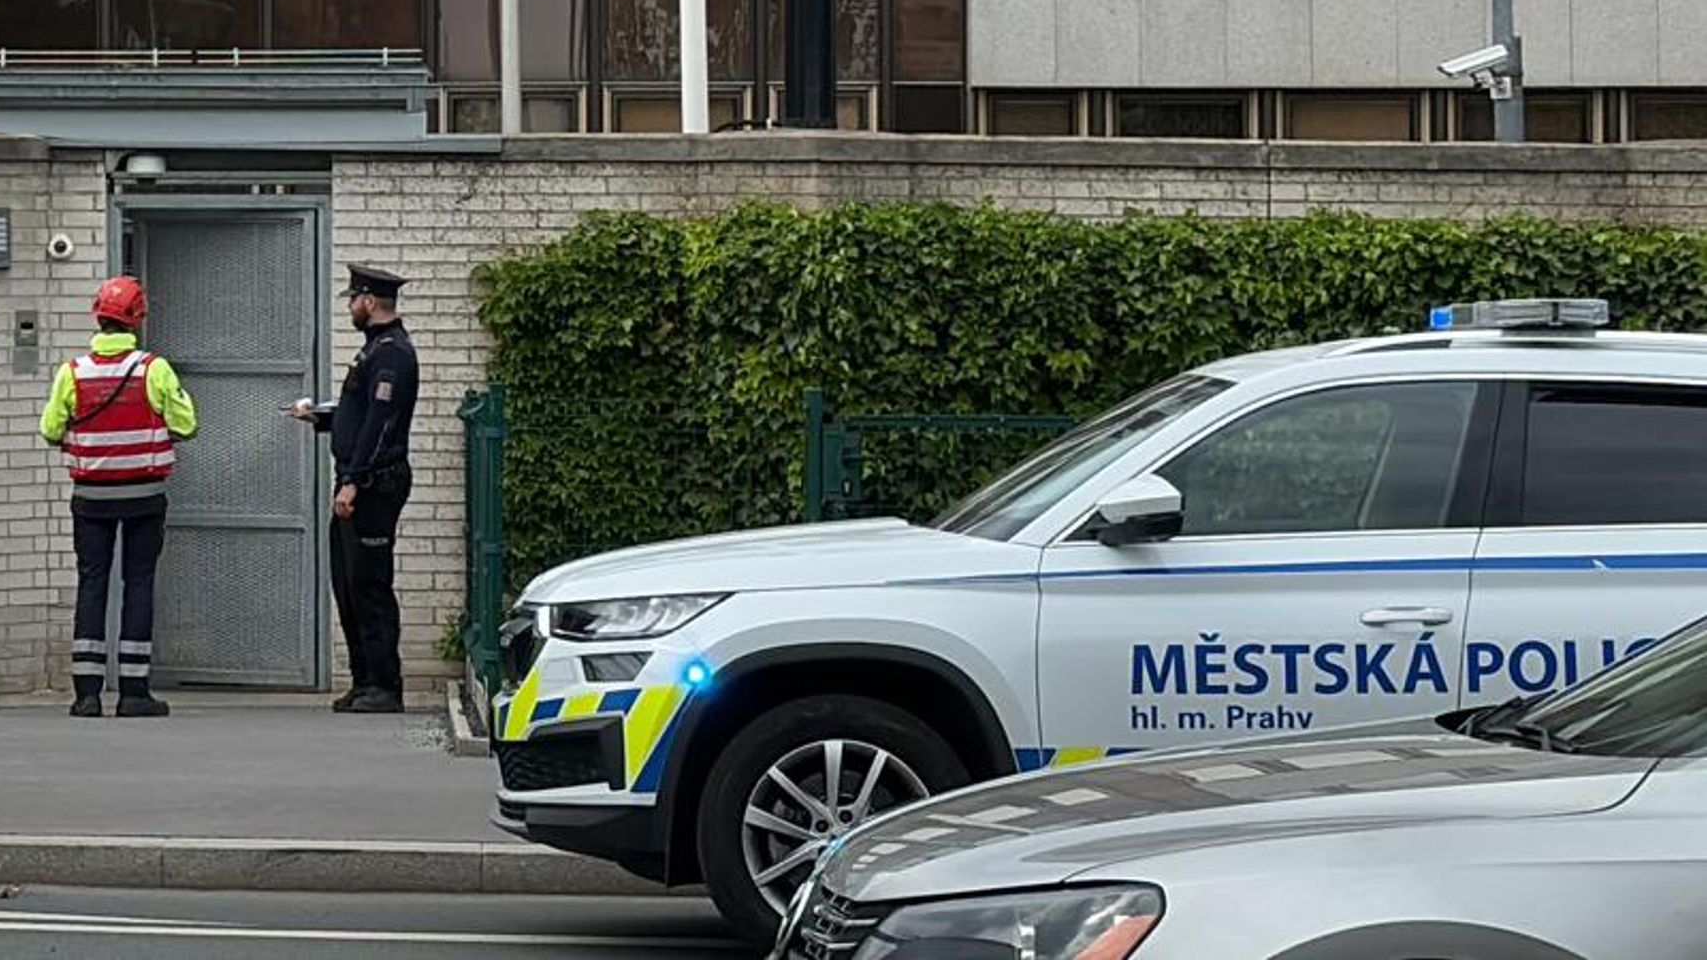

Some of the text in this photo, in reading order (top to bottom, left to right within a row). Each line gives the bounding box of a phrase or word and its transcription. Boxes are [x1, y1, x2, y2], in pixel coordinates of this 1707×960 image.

[1131, 632, 1657, 695] MĚSTSKÁ POL
[1131, 705, 1167, 729] hl.
[1178, 711, 1215, 729] m.
